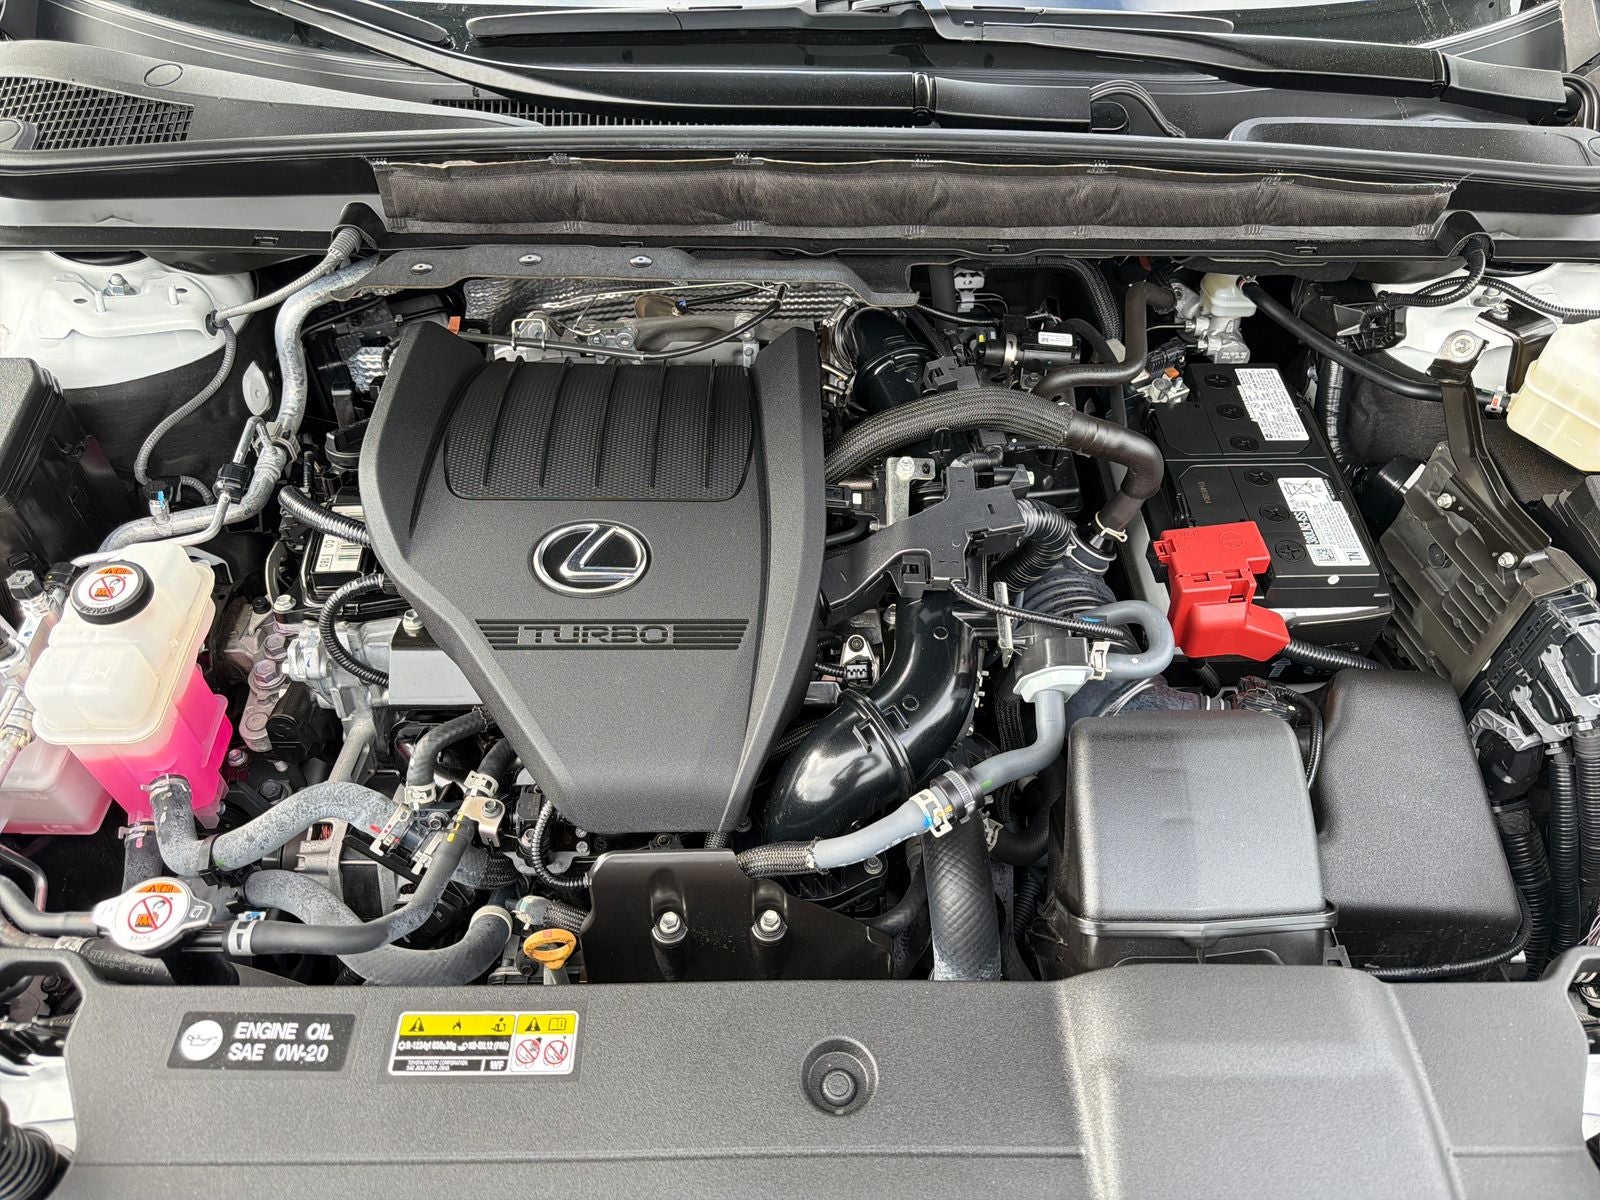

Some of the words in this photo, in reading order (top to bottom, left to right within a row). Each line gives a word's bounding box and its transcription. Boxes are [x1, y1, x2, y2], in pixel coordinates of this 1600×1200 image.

[80, 605, 116, 615] DENSO
[522, 624, 669, 644] TURBO
[234, 1021, 299, 1040] ENGINE
[306, 1022, 334, 1041] OIL
[227, 1042, 266, 1061] SAE
[274, 1043, 329, 1063] 0W-20
[490, 1060, 505, 1070] WF
